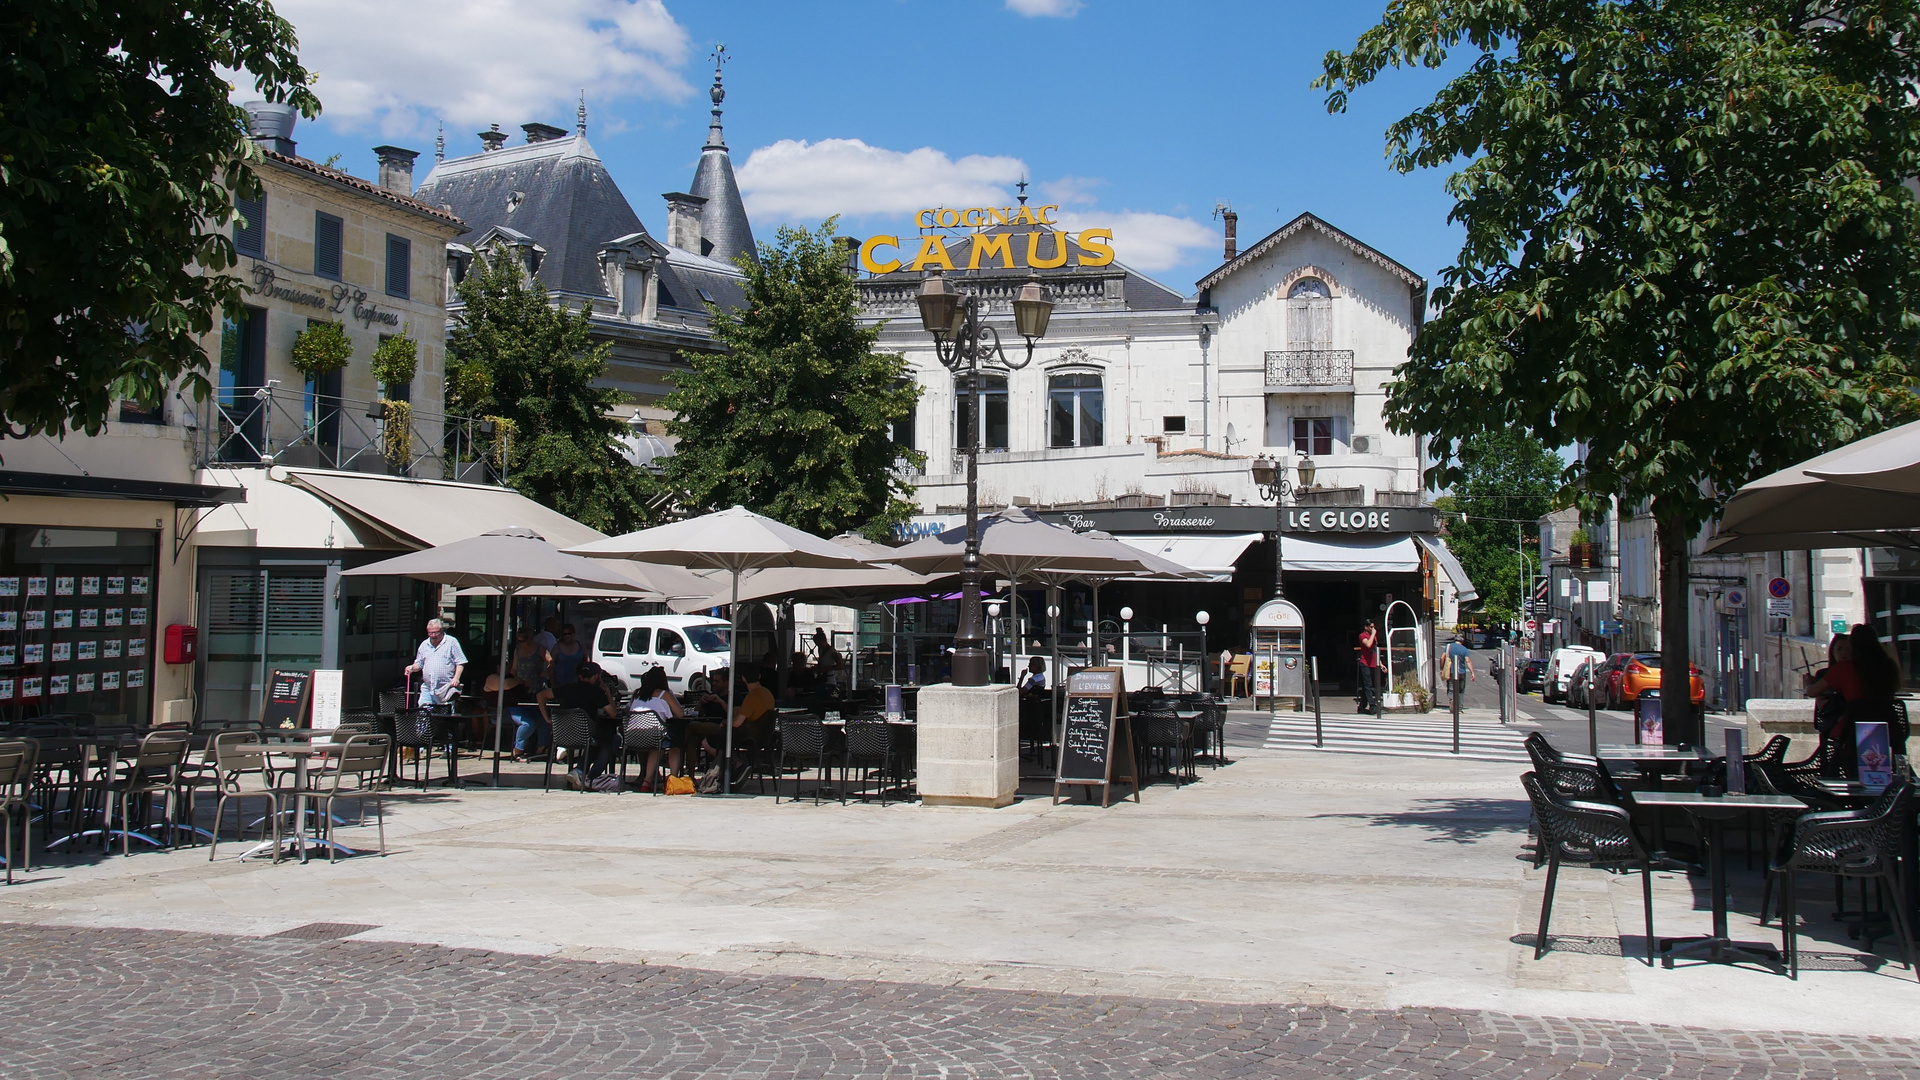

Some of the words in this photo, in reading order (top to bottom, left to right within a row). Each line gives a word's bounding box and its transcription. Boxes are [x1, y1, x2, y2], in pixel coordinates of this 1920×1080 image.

[914, 204, 1059, 229] COGNAC
[860, 228, 1115, 274] CAMUS
[252, 264, 326, 311] Brasserie
[329, 285, 400, 330] L'Express
[1068, 514, 1096, 529] Bar
[1153, 512, 1216, 528] Brasserie
[1289, 511, 1311, 528] LE
[1320, 511, 1390, 529] GLOBE
[1268, 612, 1290, 622] GLOBE
[1078, 682, 1111, 691] L'EXPRESS
